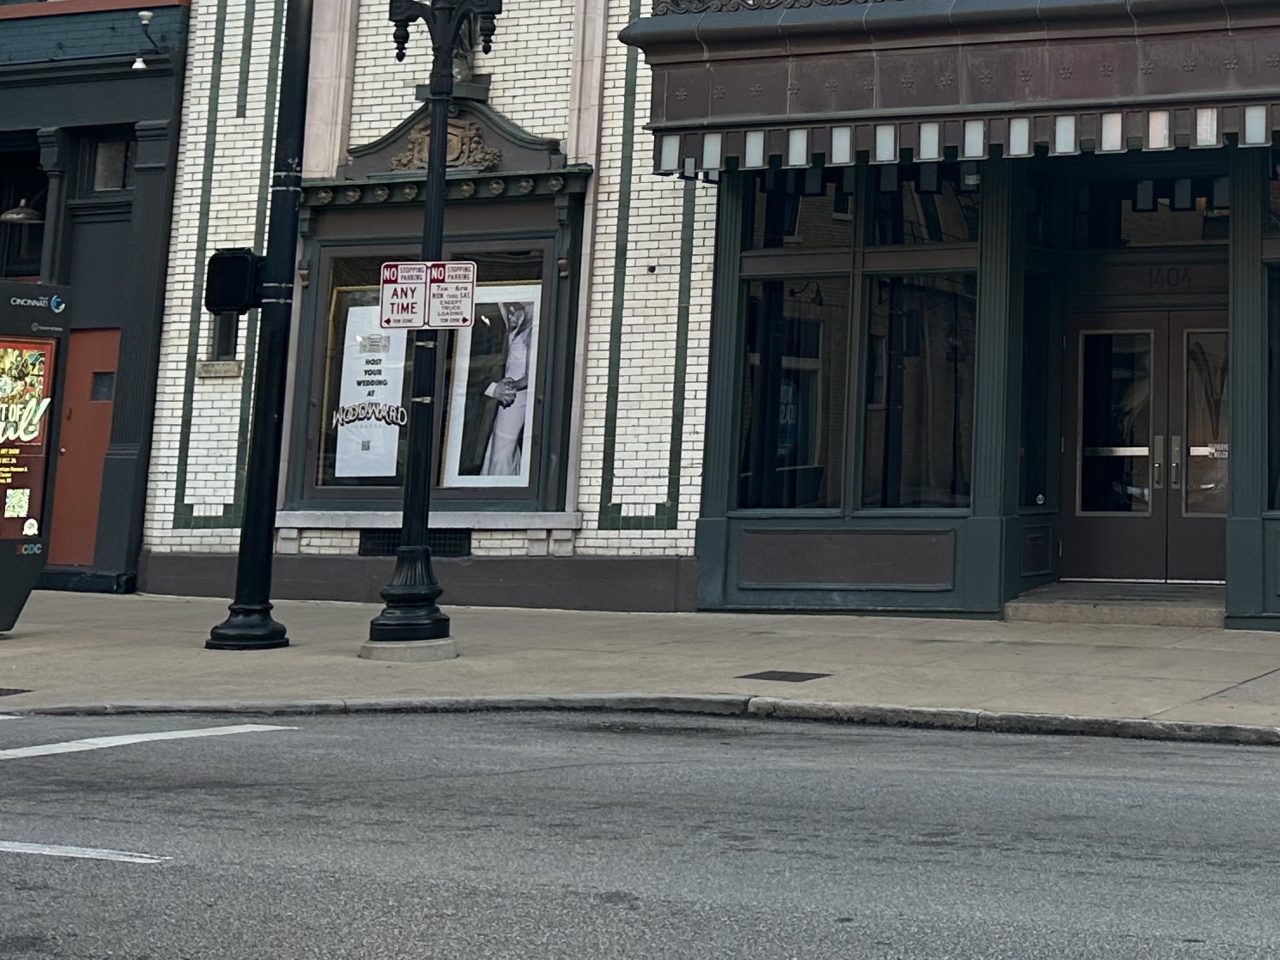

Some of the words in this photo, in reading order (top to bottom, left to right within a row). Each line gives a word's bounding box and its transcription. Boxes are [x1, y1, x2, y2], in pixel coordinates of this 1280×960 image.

[383, 267, 397, 281] NO
[431, 267, 445, 280] NO
[1149, 267, 1192, 289] 1404
[391, 286, 417, 299] ANY
[390, 302, 418, 315] TIME
[332, 402, 408, 428] WOODWARD
